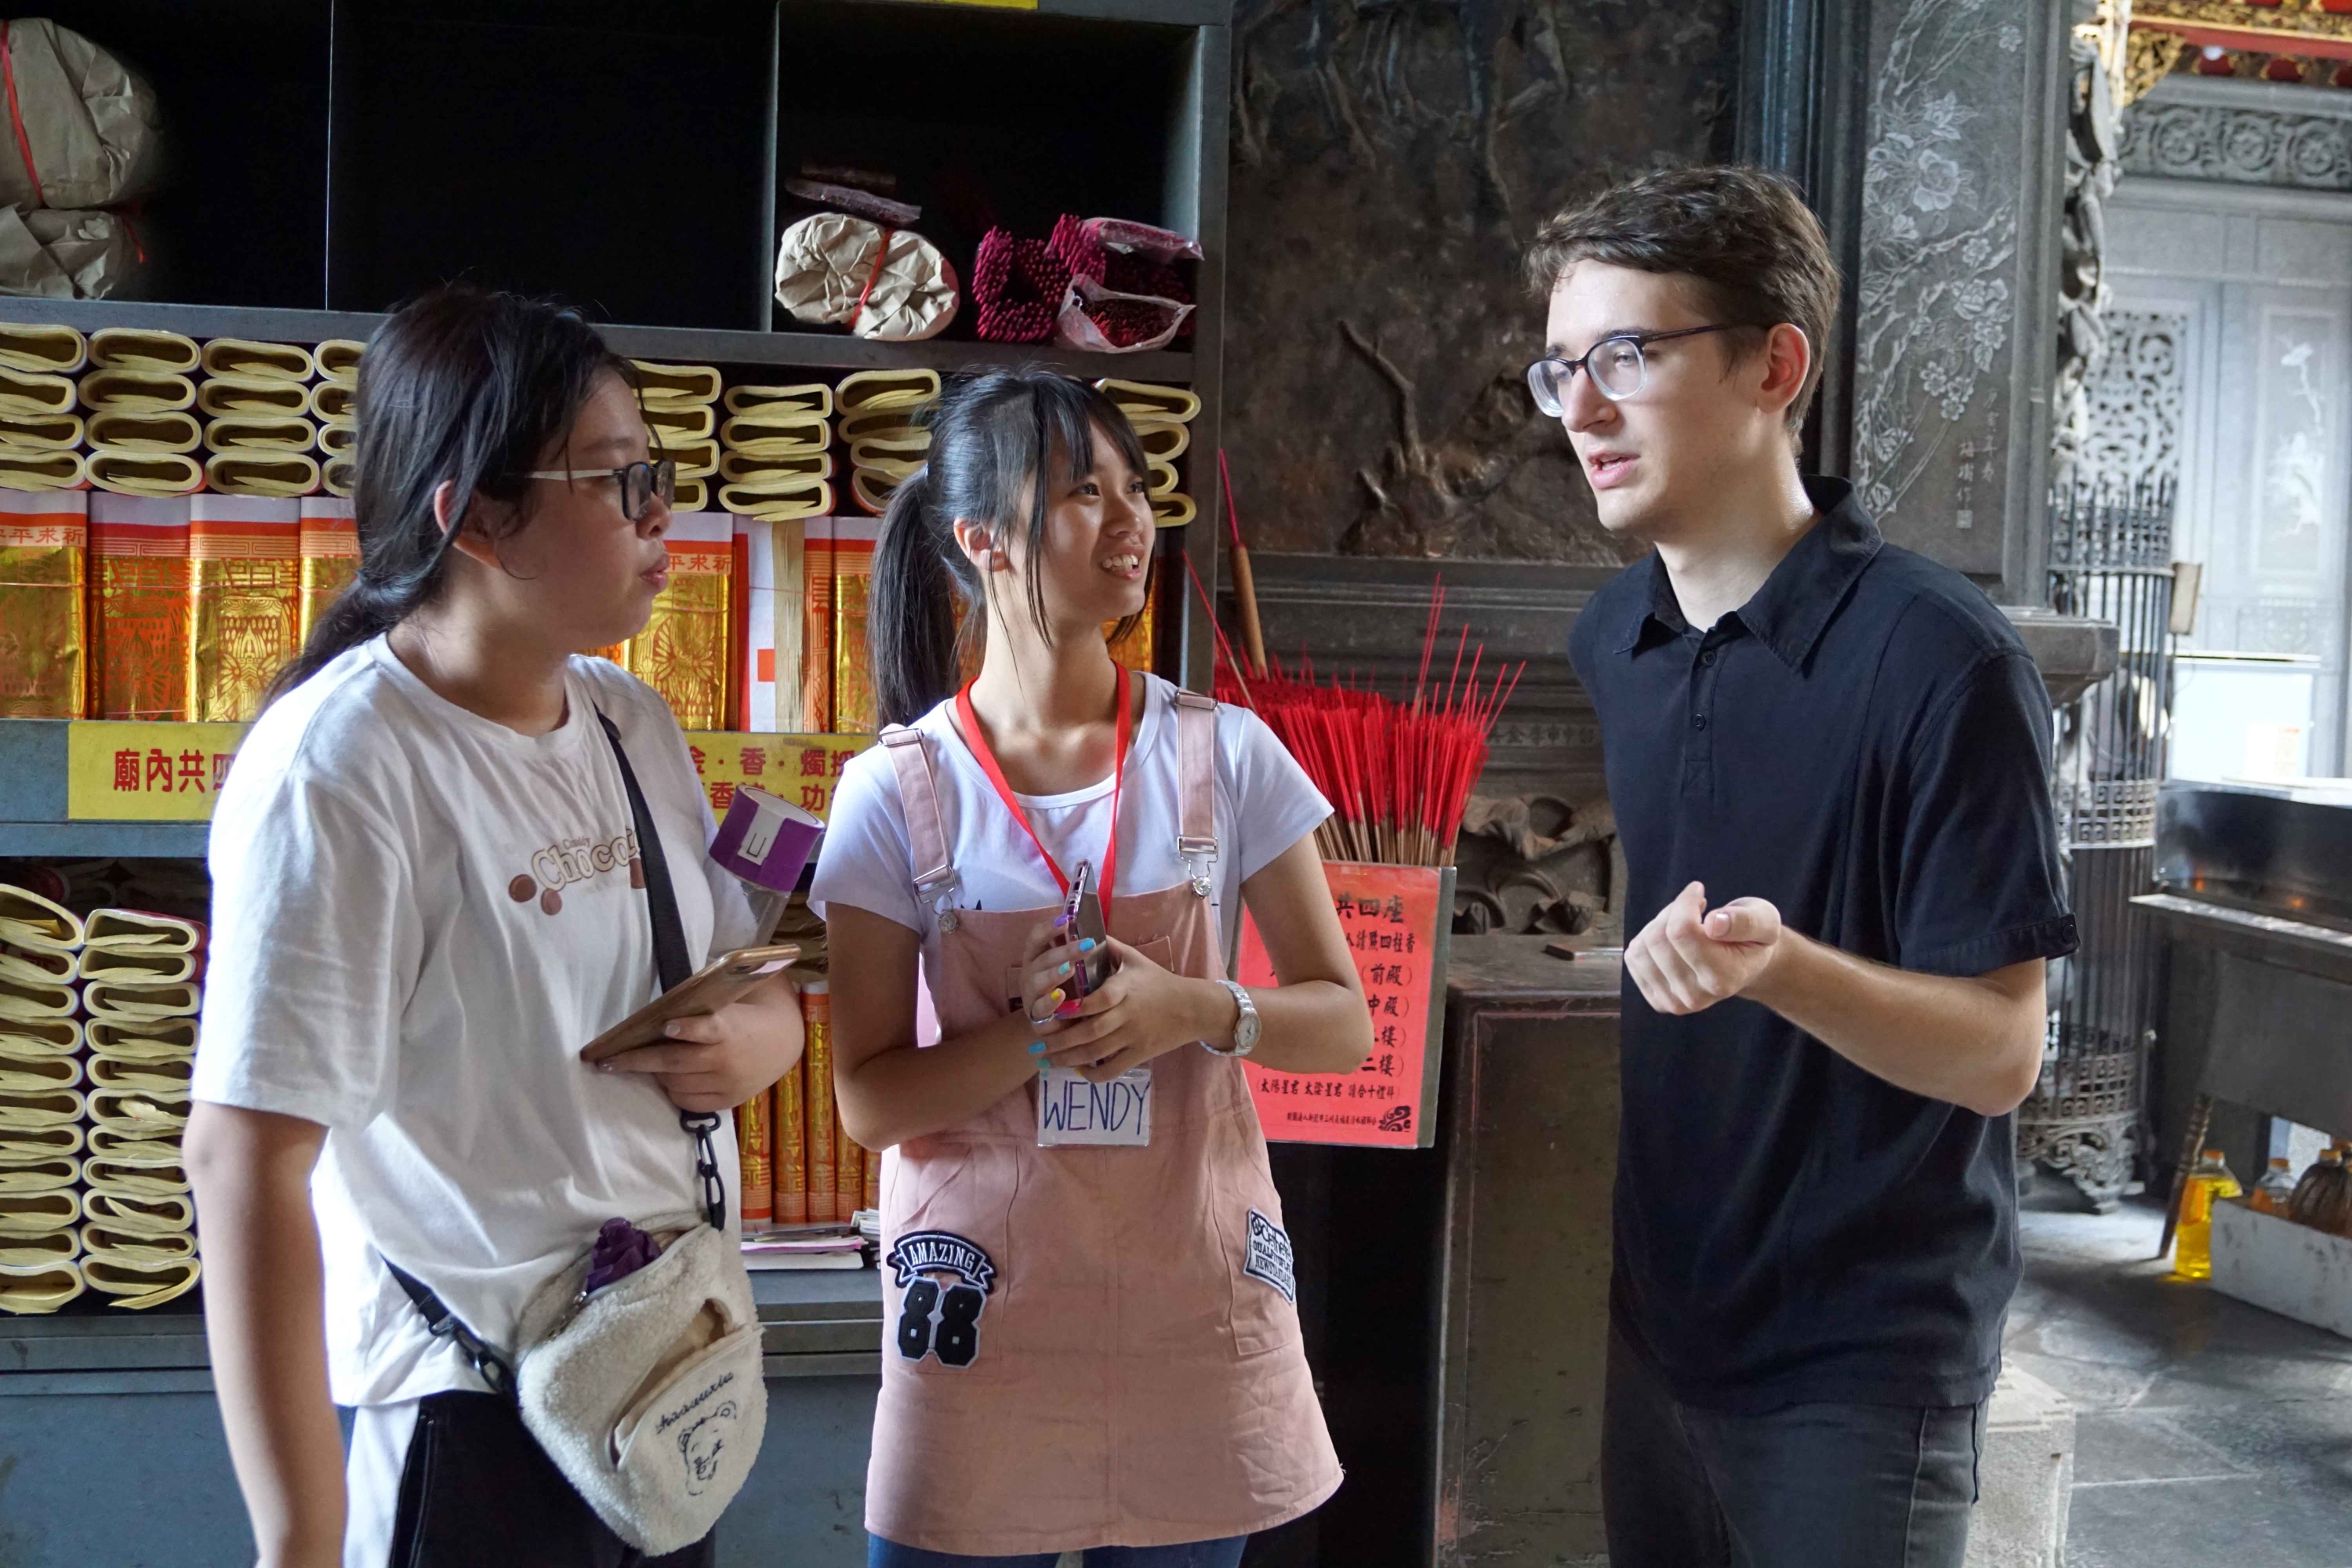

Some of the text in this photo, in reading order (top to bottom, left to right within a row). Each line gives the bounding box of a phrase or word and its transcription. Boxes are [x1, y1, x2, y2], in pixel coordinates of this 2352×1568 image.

[1044, 1080, 1151, 1136] WENDY
[908, 1242, 975, 1270] AMAZING
[898, 1277, 987, 1368] 88
